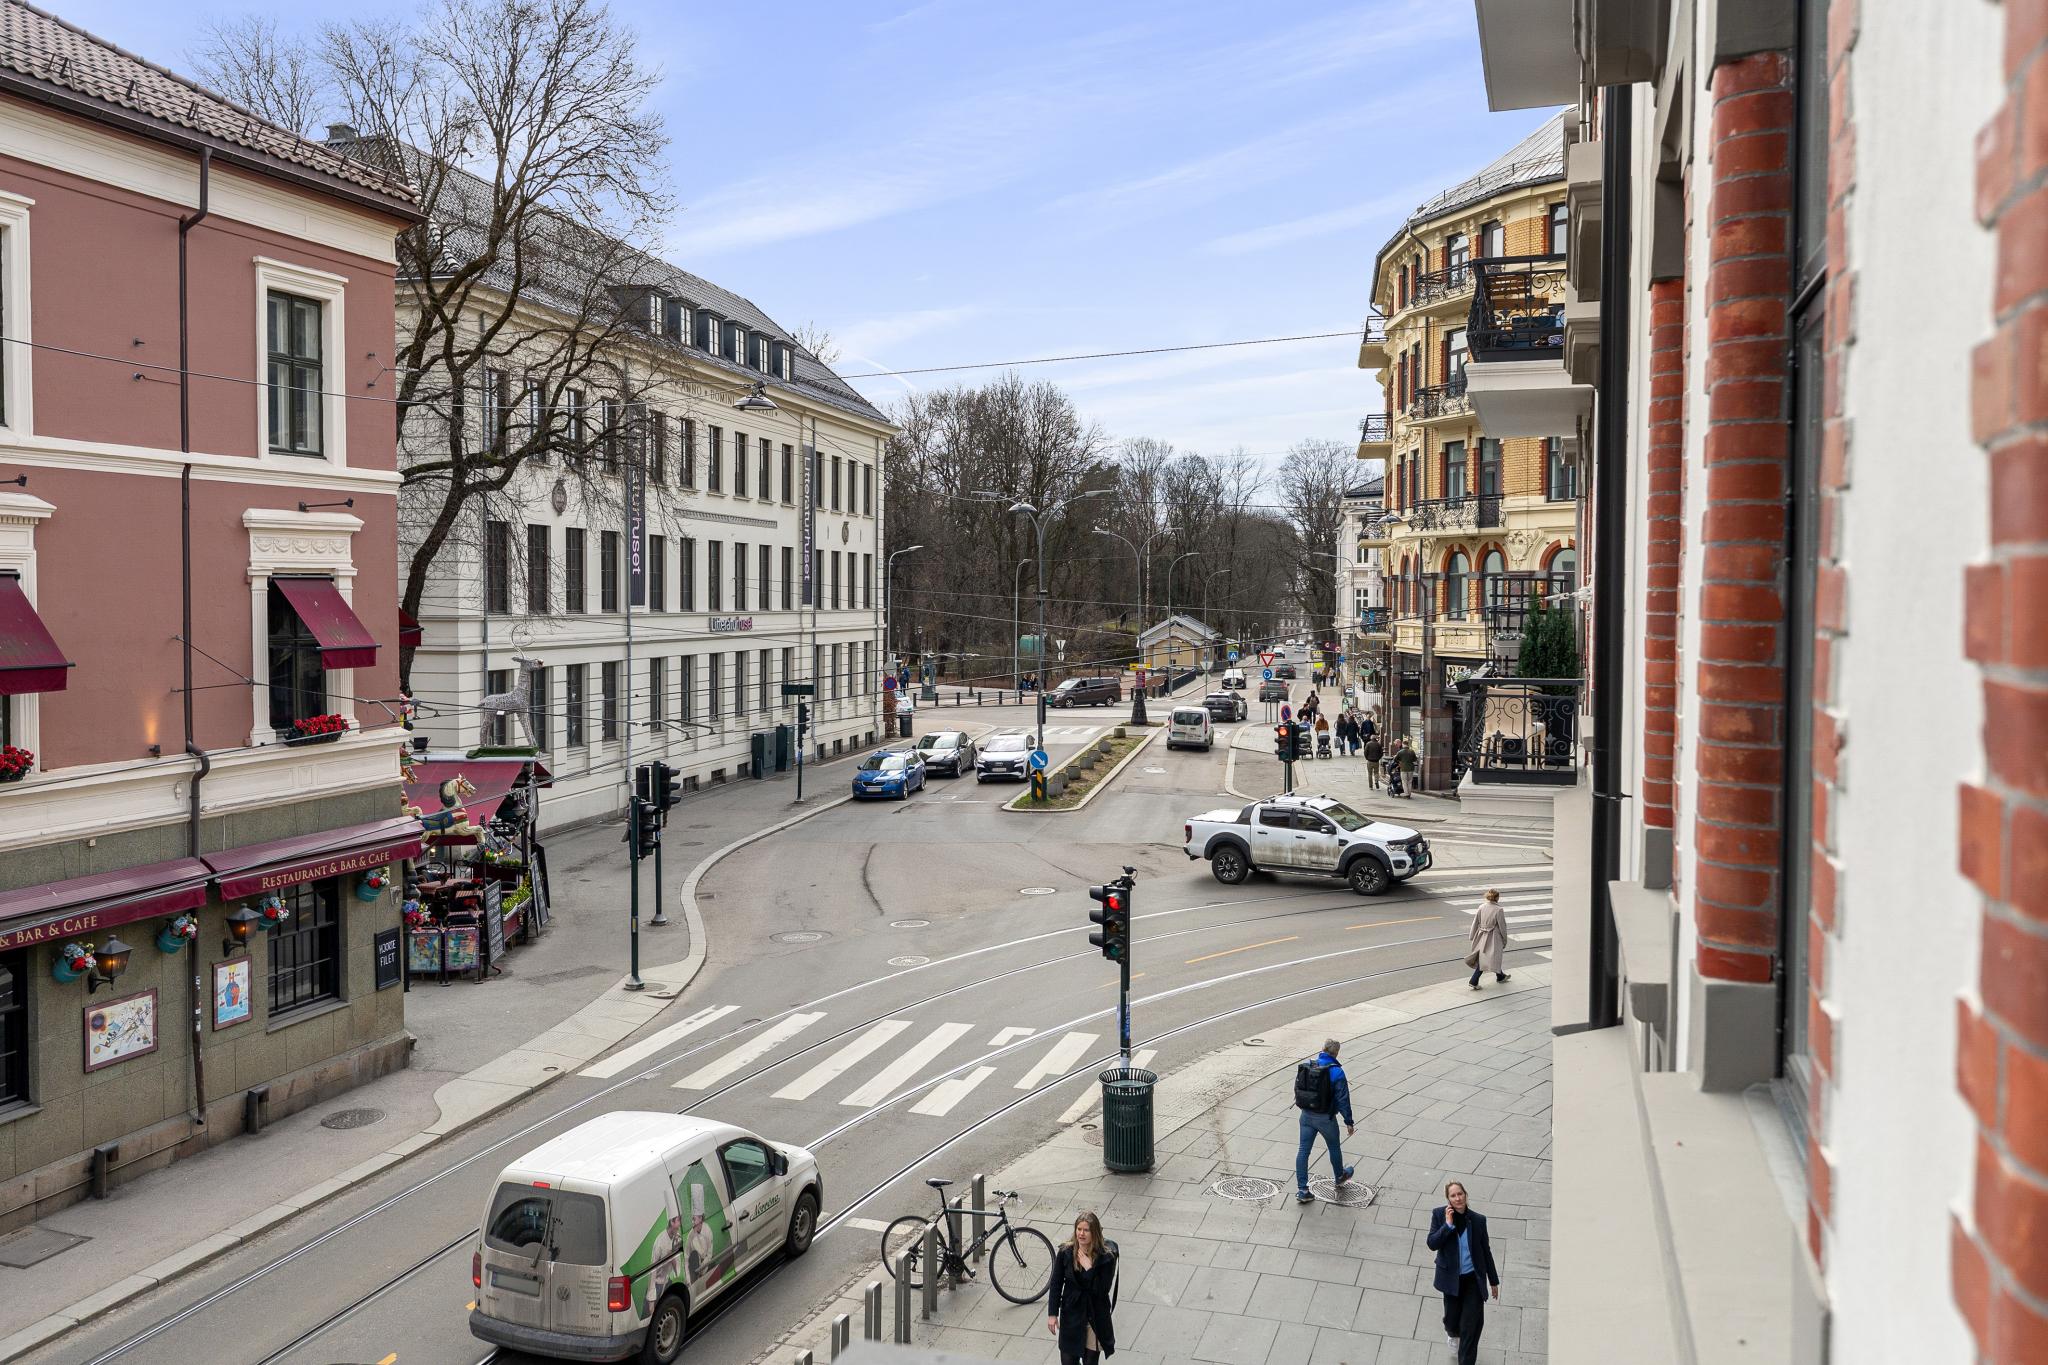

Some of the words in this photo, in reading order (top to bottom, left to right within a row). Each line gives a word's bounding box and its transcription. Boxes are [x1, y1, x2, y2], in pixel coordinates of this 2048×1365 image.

[340, 858, 358, 871] BAR
[16, 928, 44, 944] BAR
[49, 923, 60, 936] &
[380, 951, 396, 967] FILET
